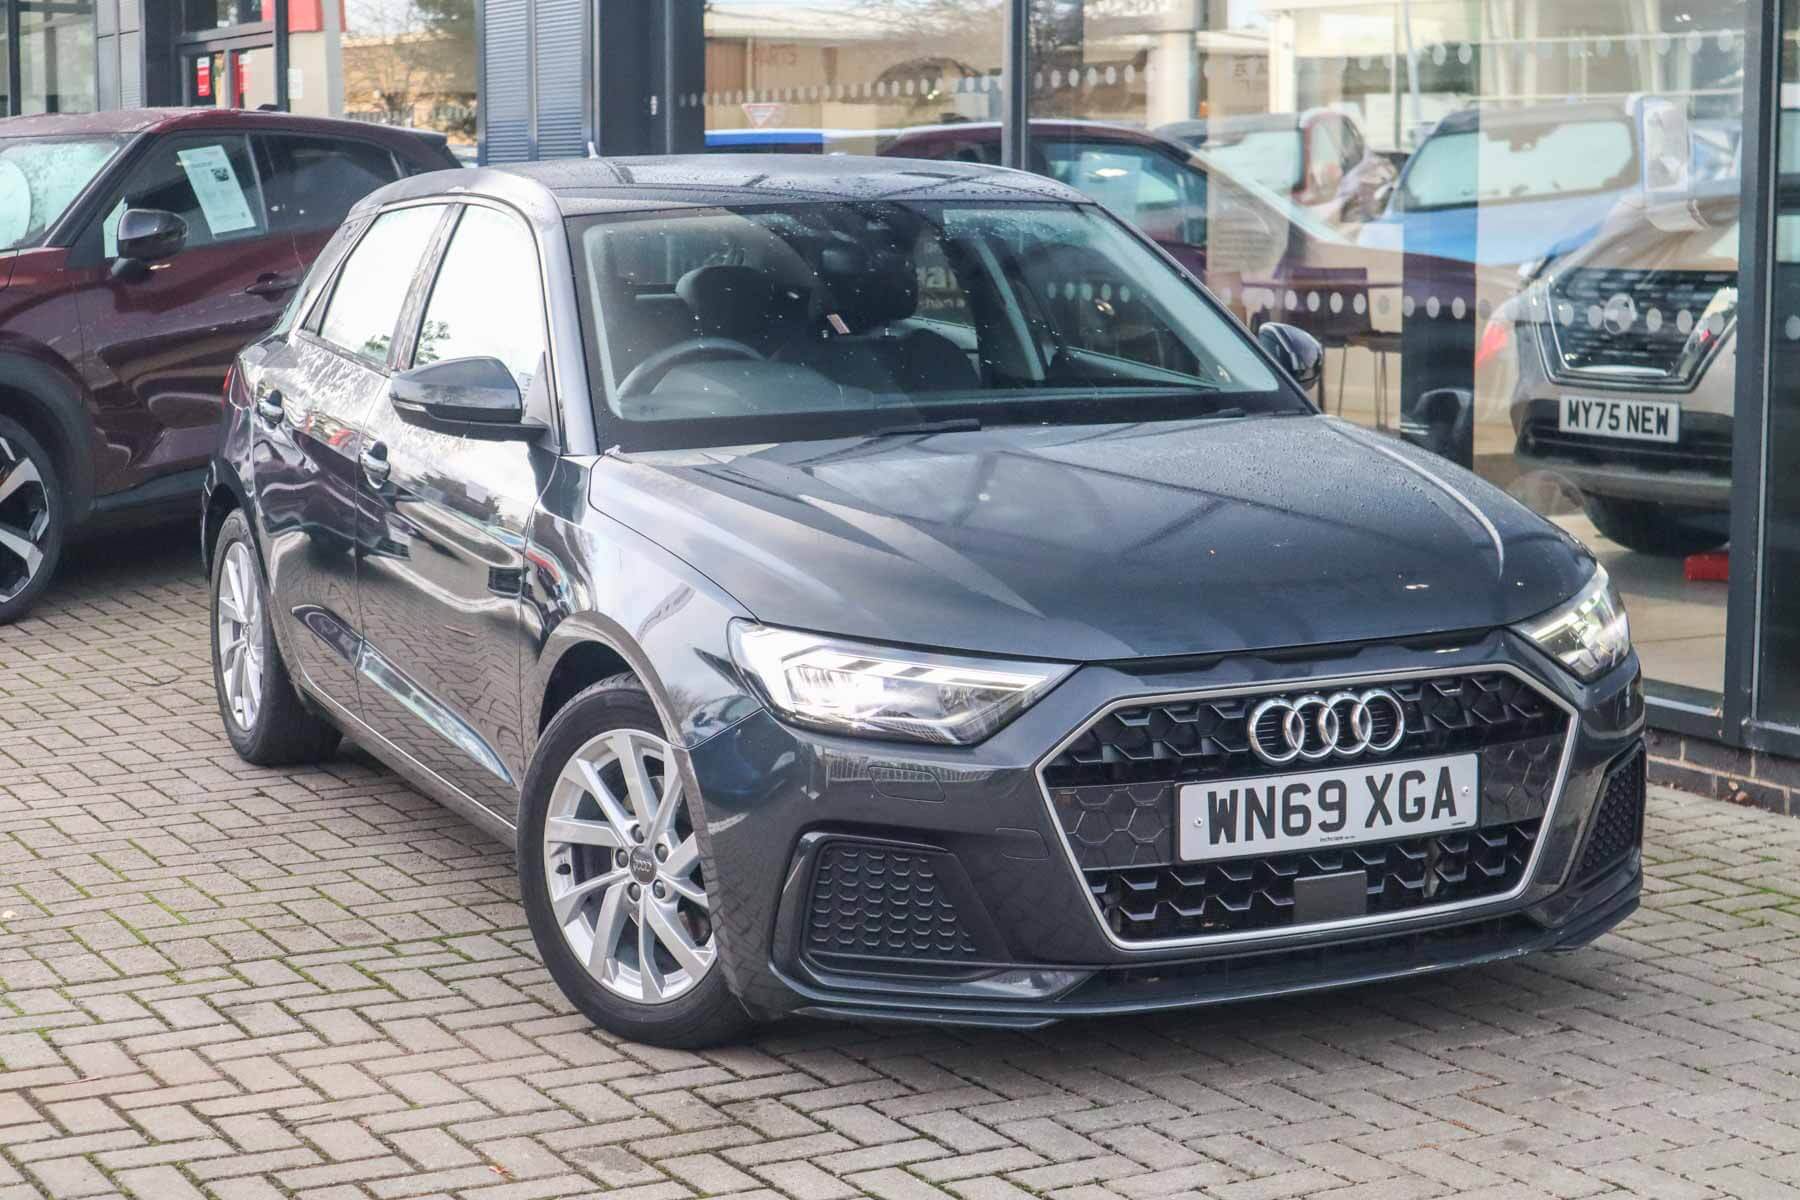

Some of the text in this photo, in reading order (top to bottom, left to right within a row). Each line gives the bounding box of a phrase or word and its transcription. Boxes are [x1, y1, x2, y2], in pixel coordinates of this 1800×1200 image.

[1568, 399, 1669, 436] MY75 NEW
[1207, 766, 1457, 845] WN69 XGA
